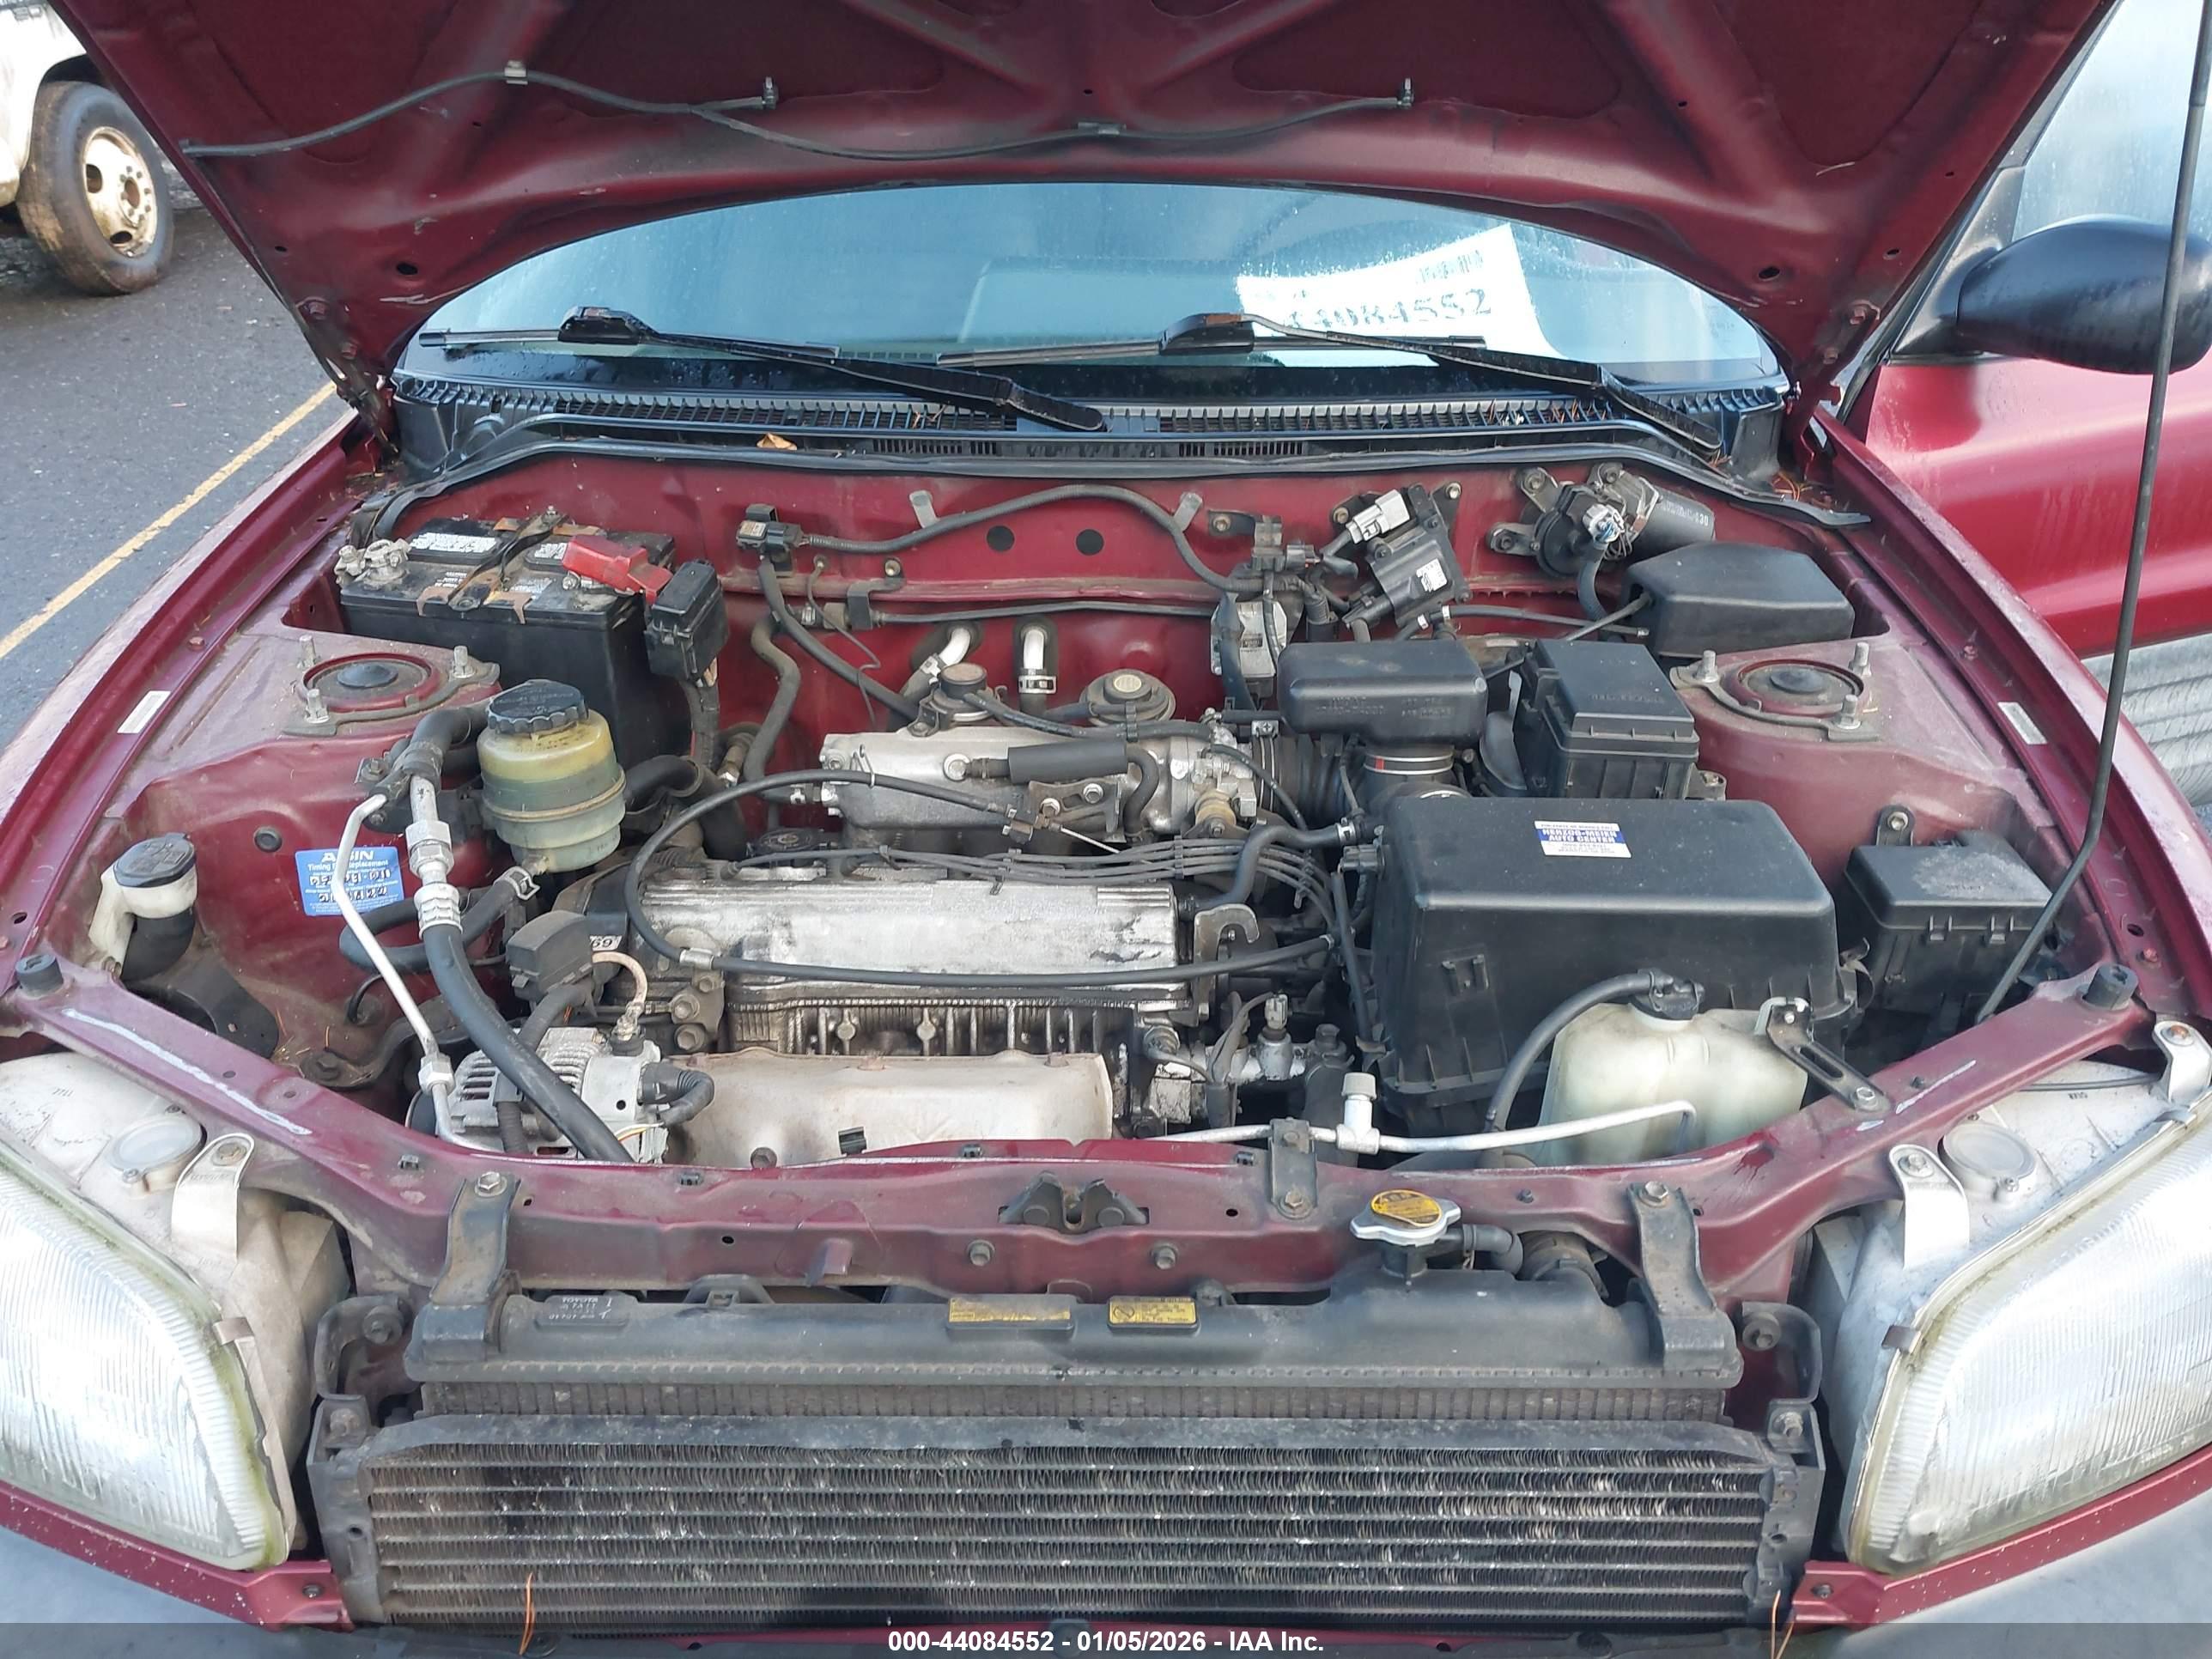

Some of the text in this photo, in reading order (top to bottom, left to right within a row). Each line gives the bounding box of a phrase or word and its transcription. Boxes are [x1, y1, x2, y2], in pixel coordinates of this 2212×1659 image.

[320, 850, 374, 863] AIN
[307, 863, 331, 872] Timing
[349, 860, 389, 870] eplacement
